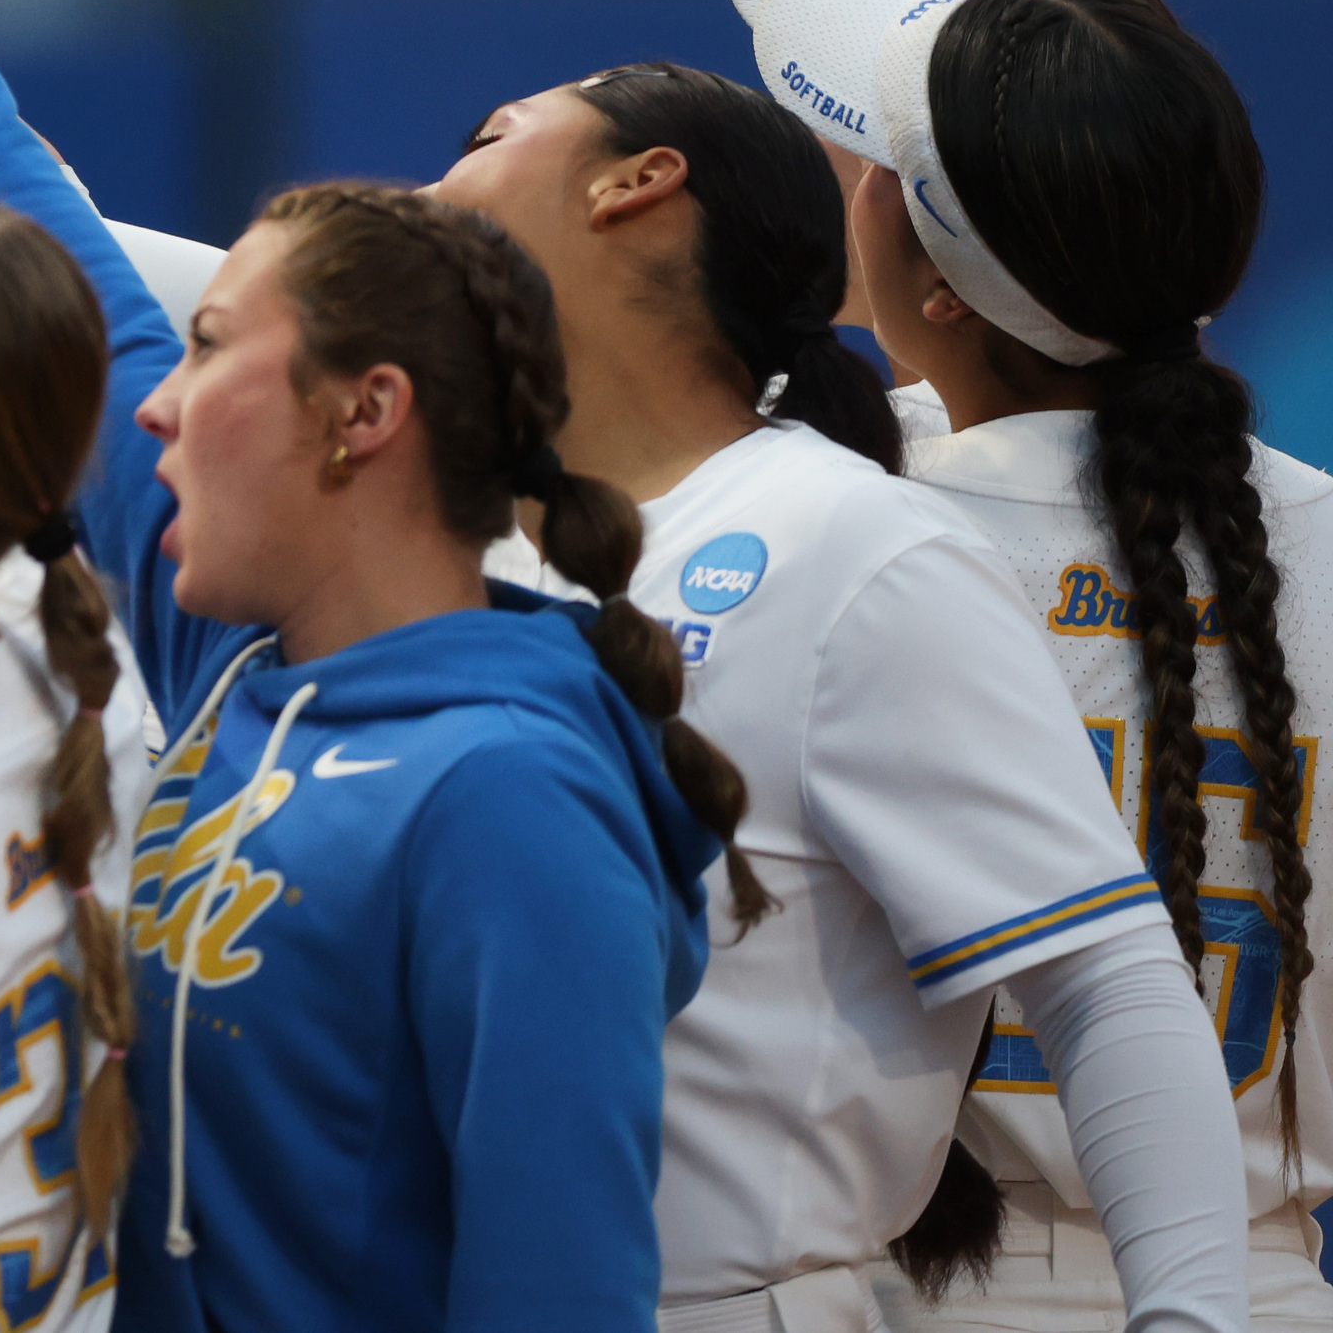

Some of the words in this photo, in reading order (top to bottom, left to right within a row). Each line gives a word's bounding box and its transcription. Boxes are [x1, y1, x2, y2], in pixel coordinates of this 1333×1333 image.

[781, 61, 866, 135] SOFTBALL
[686, 566, 755, 594] NCAA
[1053, 567, 1228, 639] Brus
